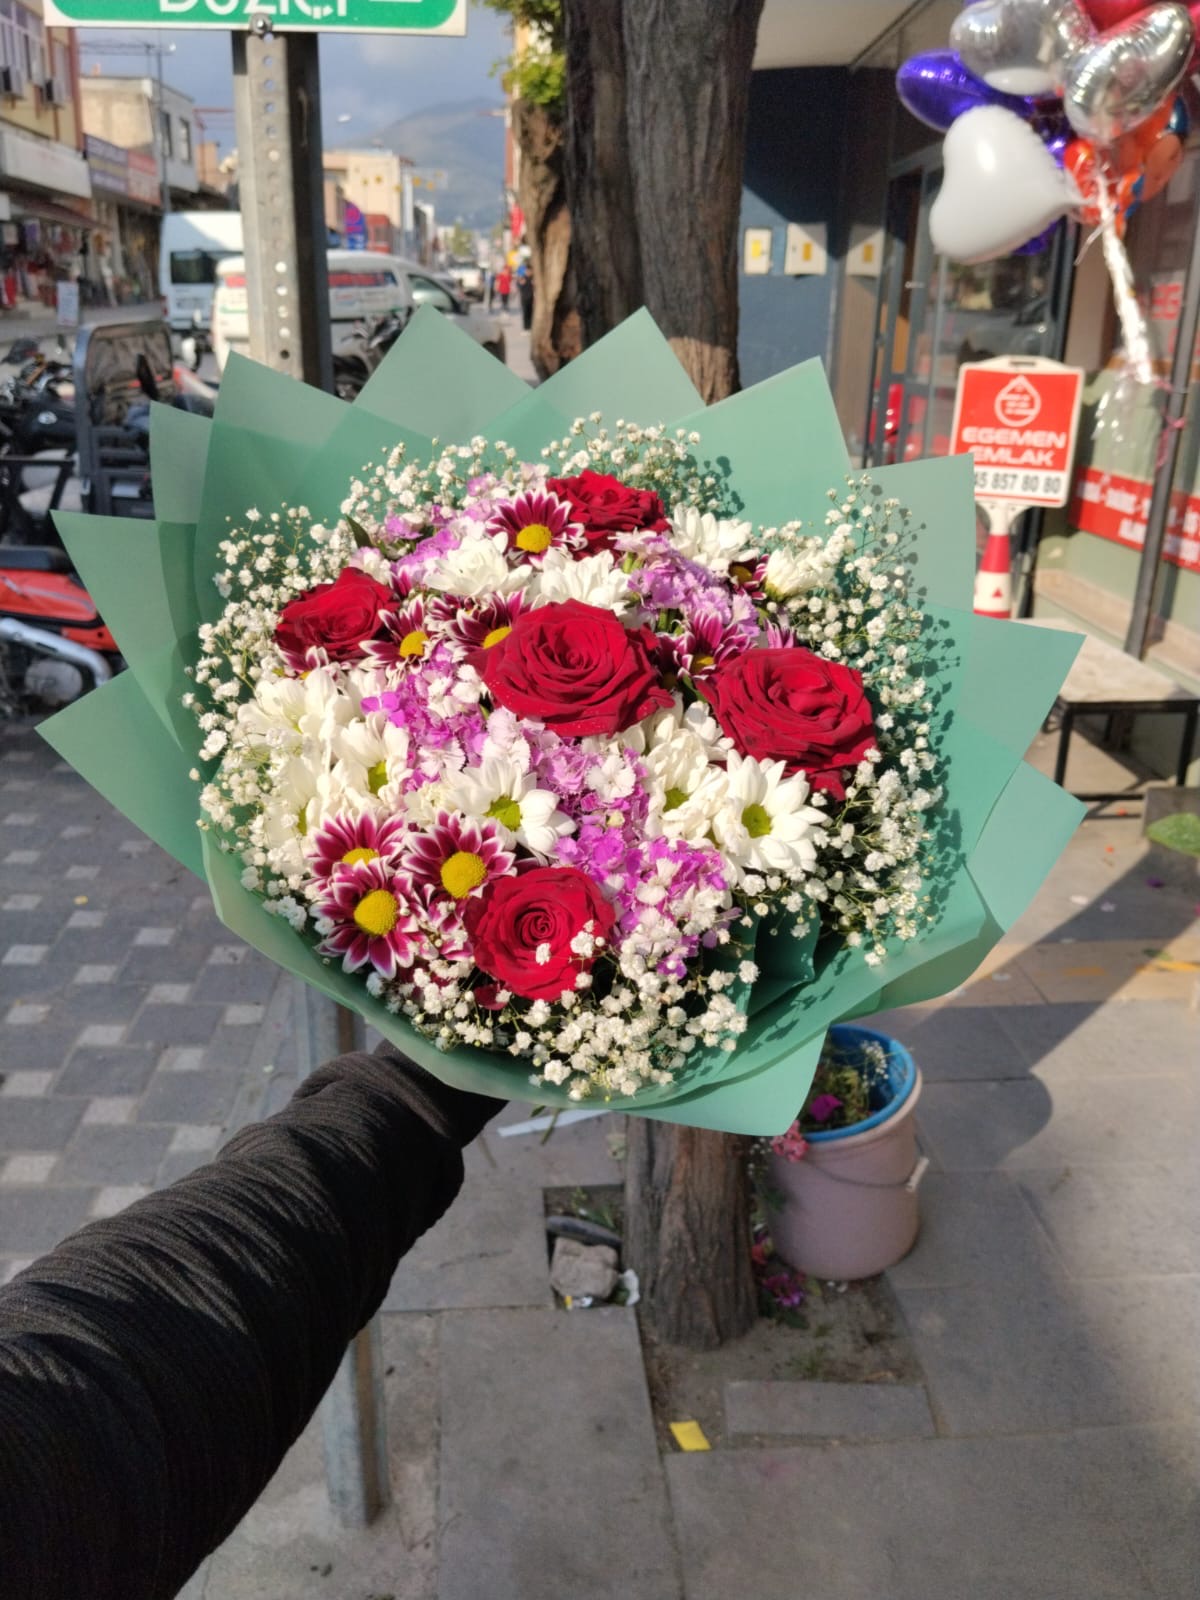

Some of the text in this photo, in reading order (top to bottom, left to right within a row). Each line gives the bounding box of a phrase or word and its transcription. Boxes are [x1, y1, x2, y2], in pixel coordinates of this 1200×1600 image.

[962, 426, 1067, 449] EGEMEN
[967, 445, 1055, 467] EMLAK
[991, 472, 1018, 491] 857
[1021, 475, 1039, 492] 80
[1043, 476, 1061, 494] 80
